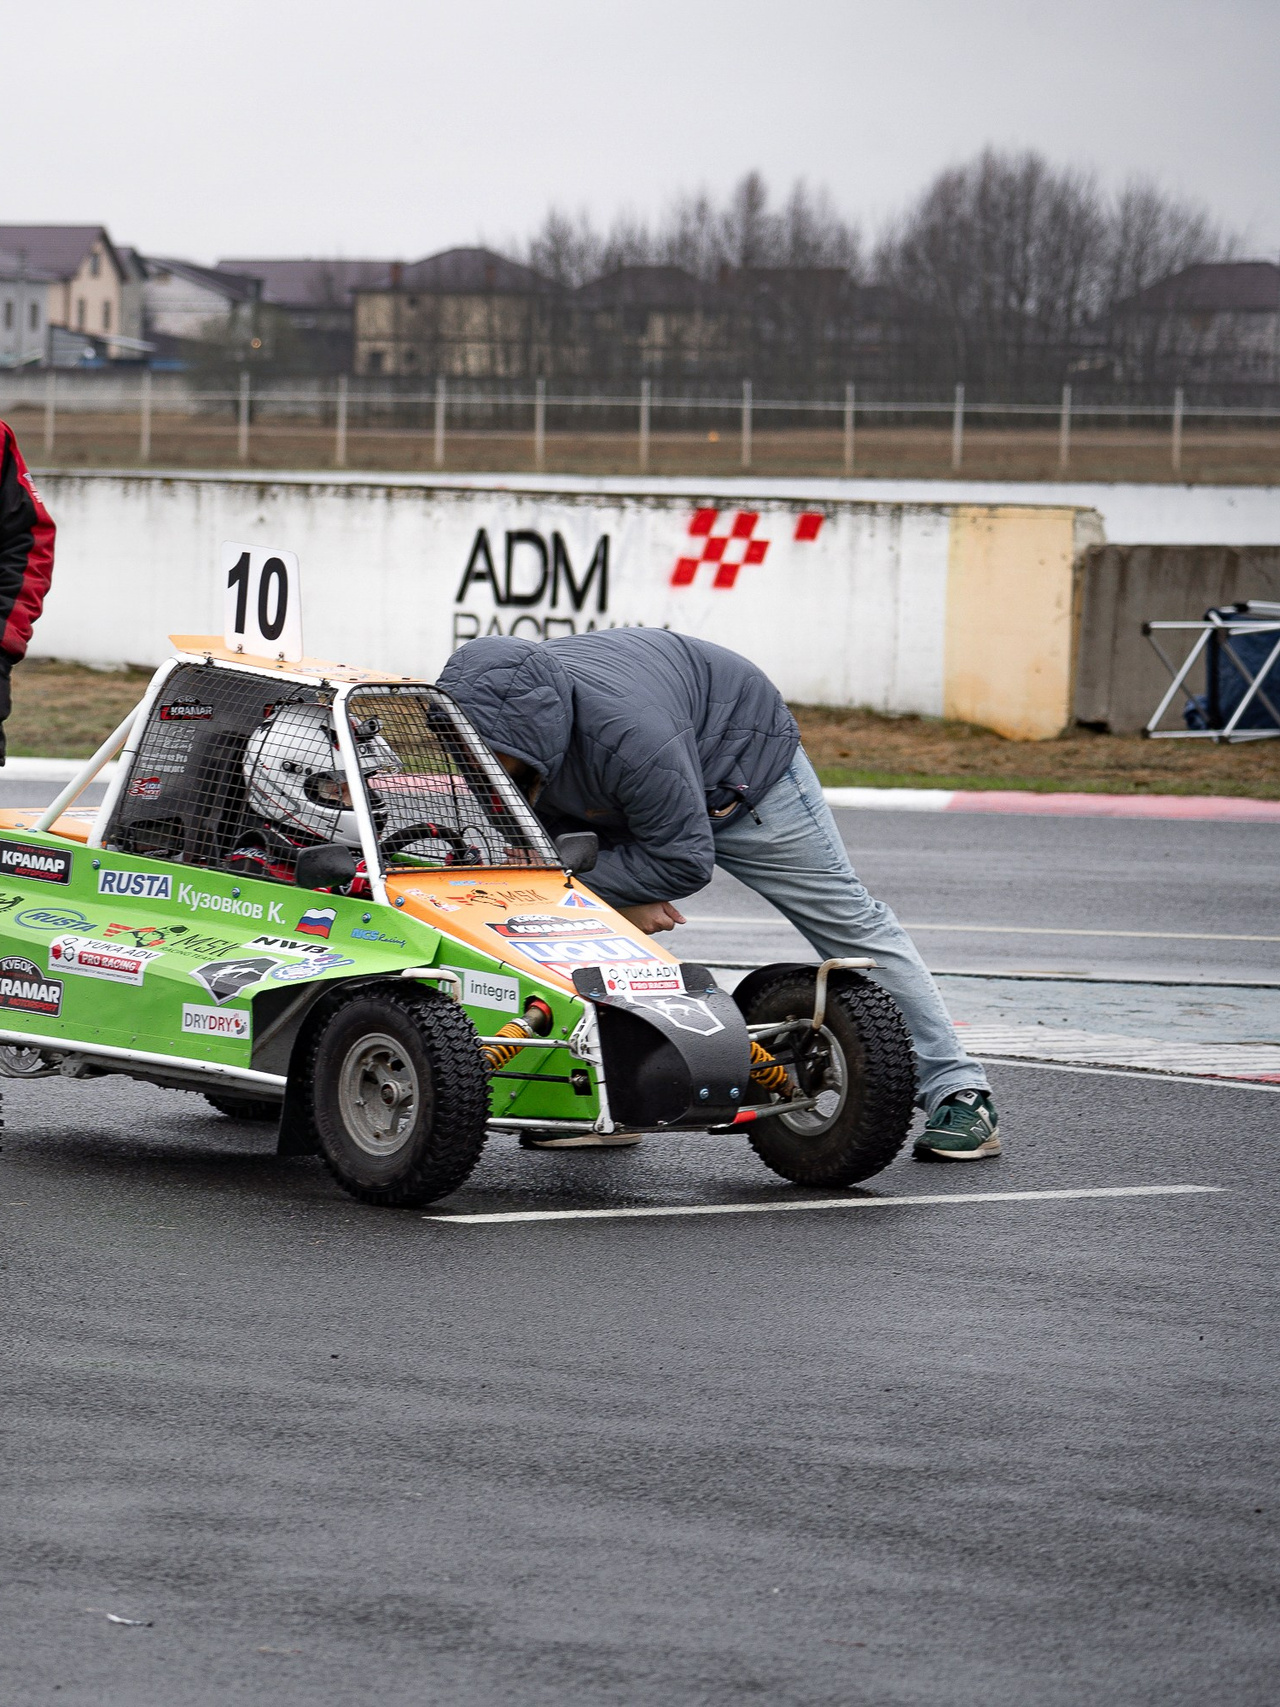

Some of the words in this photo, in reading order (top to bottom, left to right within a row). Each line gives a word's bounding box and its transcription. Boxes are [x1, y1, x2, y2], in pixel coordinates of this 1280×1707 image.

[455, 527, 609, 613] ADM
[227, 552, 288, 641] 10
[2, 850, 65, 873] КРАМАР
[100, 872, 170, 898] RUSTA
[178, 883, 264, 919] Кузовков
[25, 912, 98, 932] RUSTA
[84, 940, 121, 954] YUKA
[122, 949, 160, 960] ADV
[170, 934, 240, 957] MSK
[252, 936, 329, 954] NWB
[515, 937, 648, 963] LIQUI
[2, 959, 35, 975] КУБОК
[81, 953, 101, 966] PRO
[101, 956, 137, 972] RACING
[623, 968, 654, 979] YUKA
[656, 966, 678, 978] ADV
[470, 980, 517, 1002] integra
[184, 1012, 233, 1032] DRYDRY
